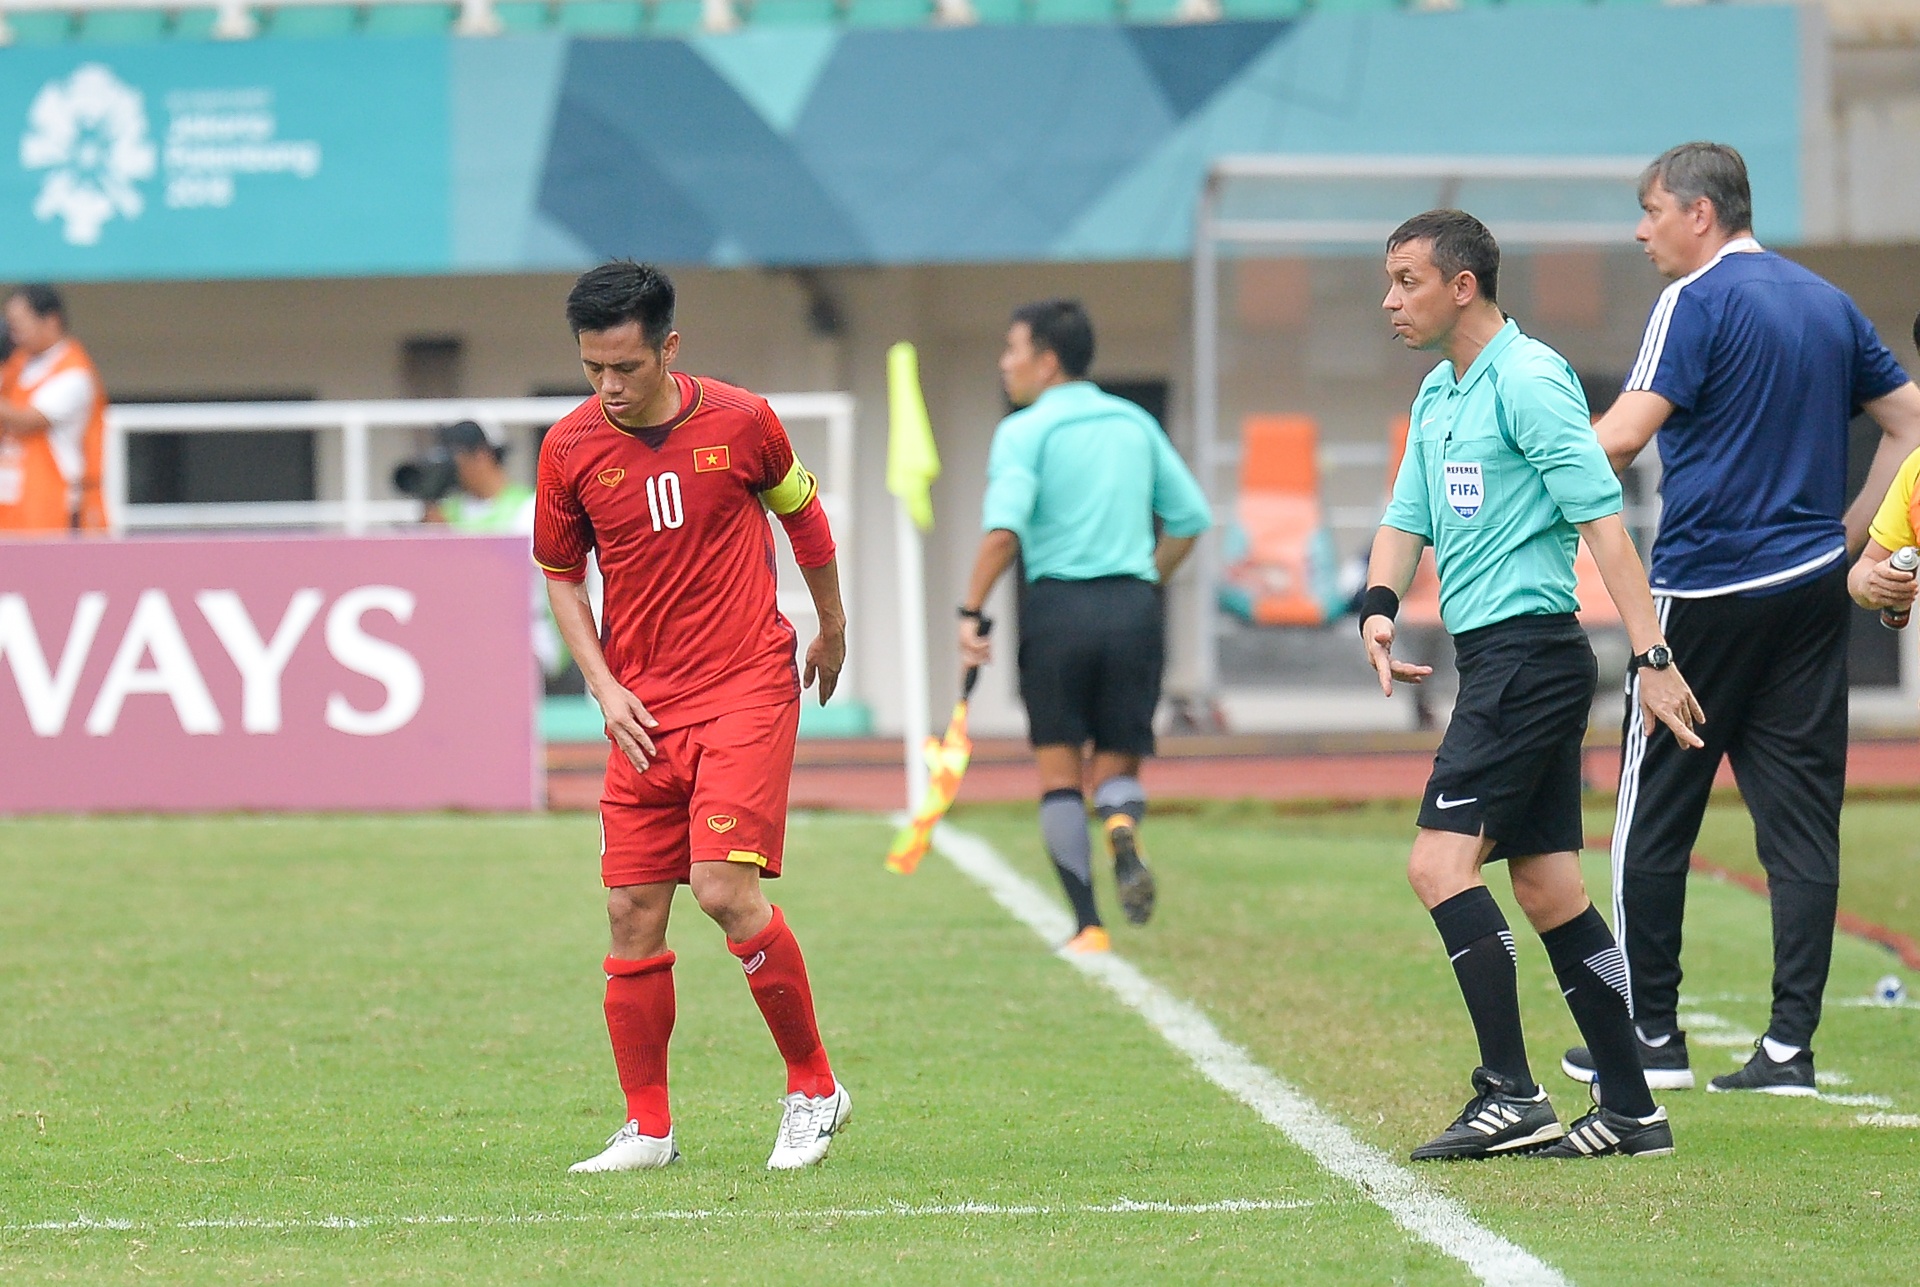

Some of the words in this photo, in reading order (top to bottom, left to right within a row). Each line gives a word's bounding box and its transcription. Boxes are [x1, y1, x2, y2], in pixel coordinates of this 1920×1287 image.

[1446, 466, 1479, 474] REFEREE
[1450, 483, 1479, 496] FIFA
[645, 471, 684, 532] 10
